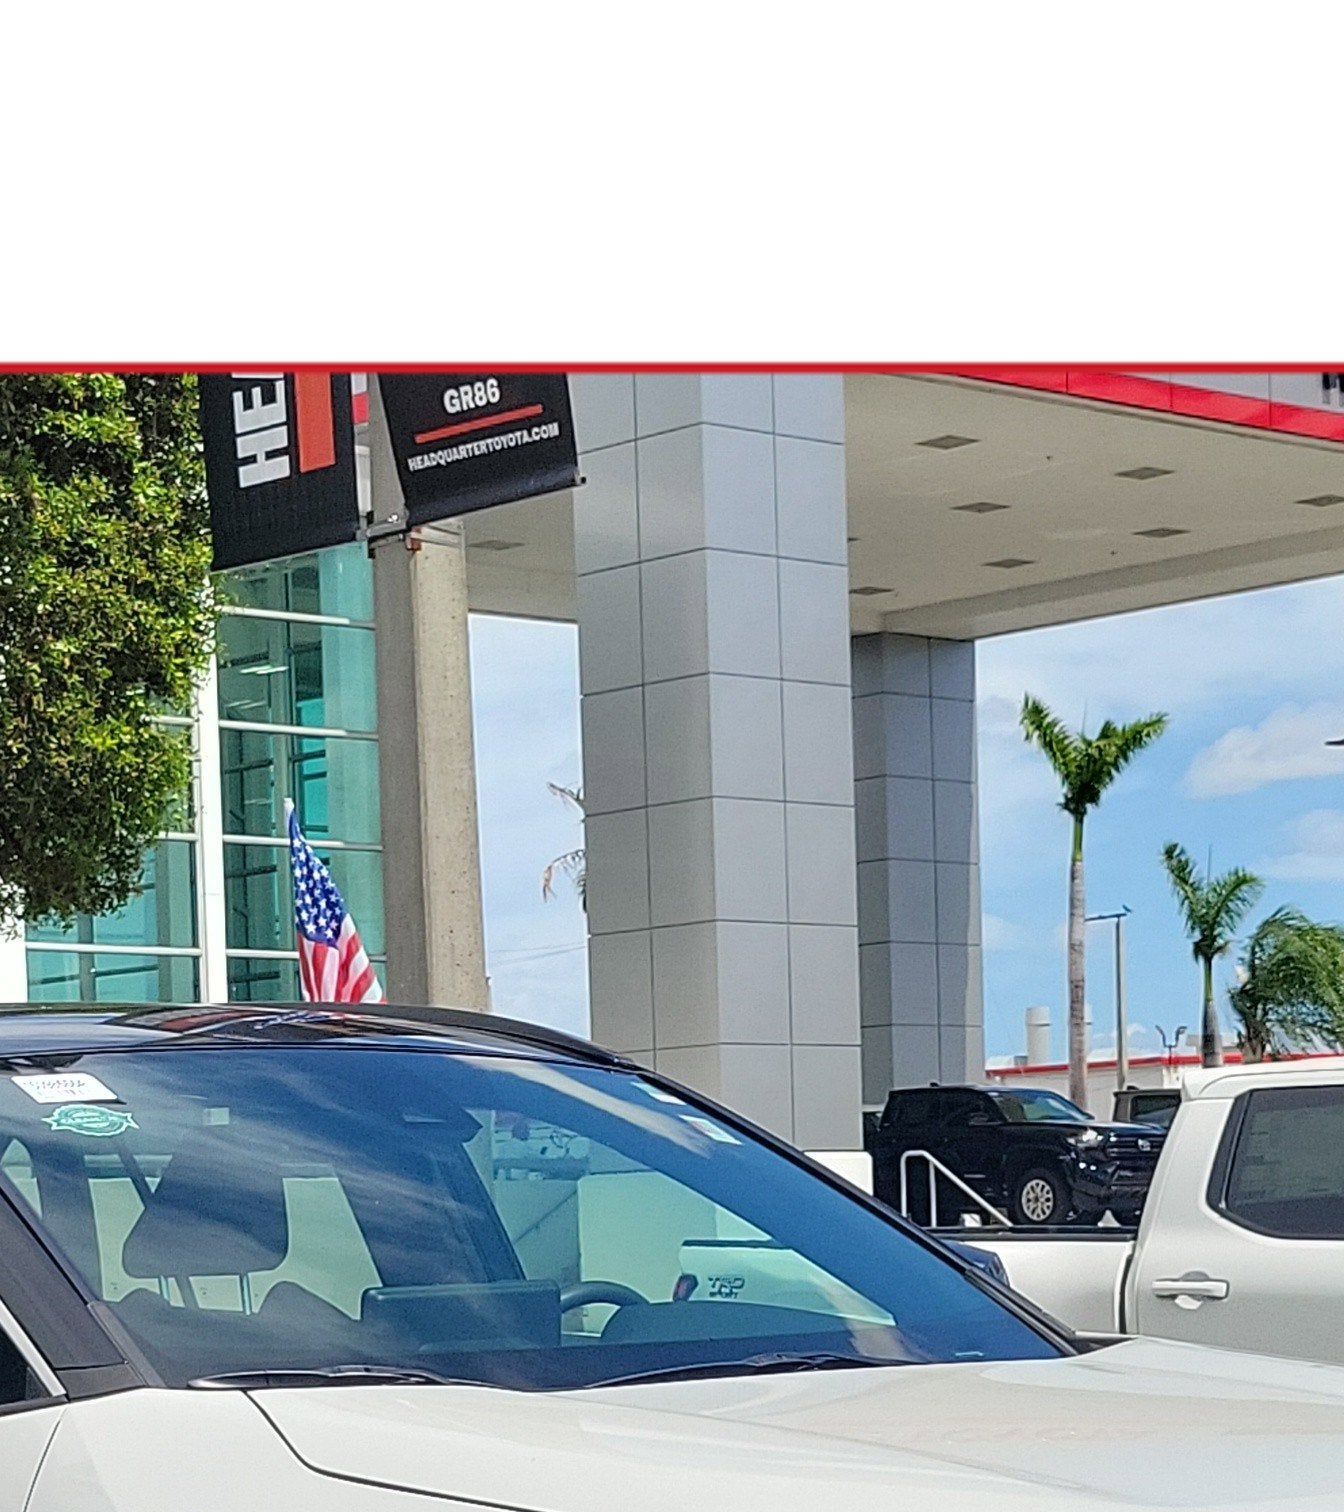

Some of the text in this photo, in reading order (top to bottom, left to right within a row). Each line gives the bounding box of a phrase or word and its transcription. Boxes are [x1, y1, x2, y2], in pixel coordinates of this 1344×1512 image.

[443, 377, 501, 414] GR86
[231, 373, 291, 488] HE
[407, 421, 560, 472] HEADQUARTERTOYOTA.COM
